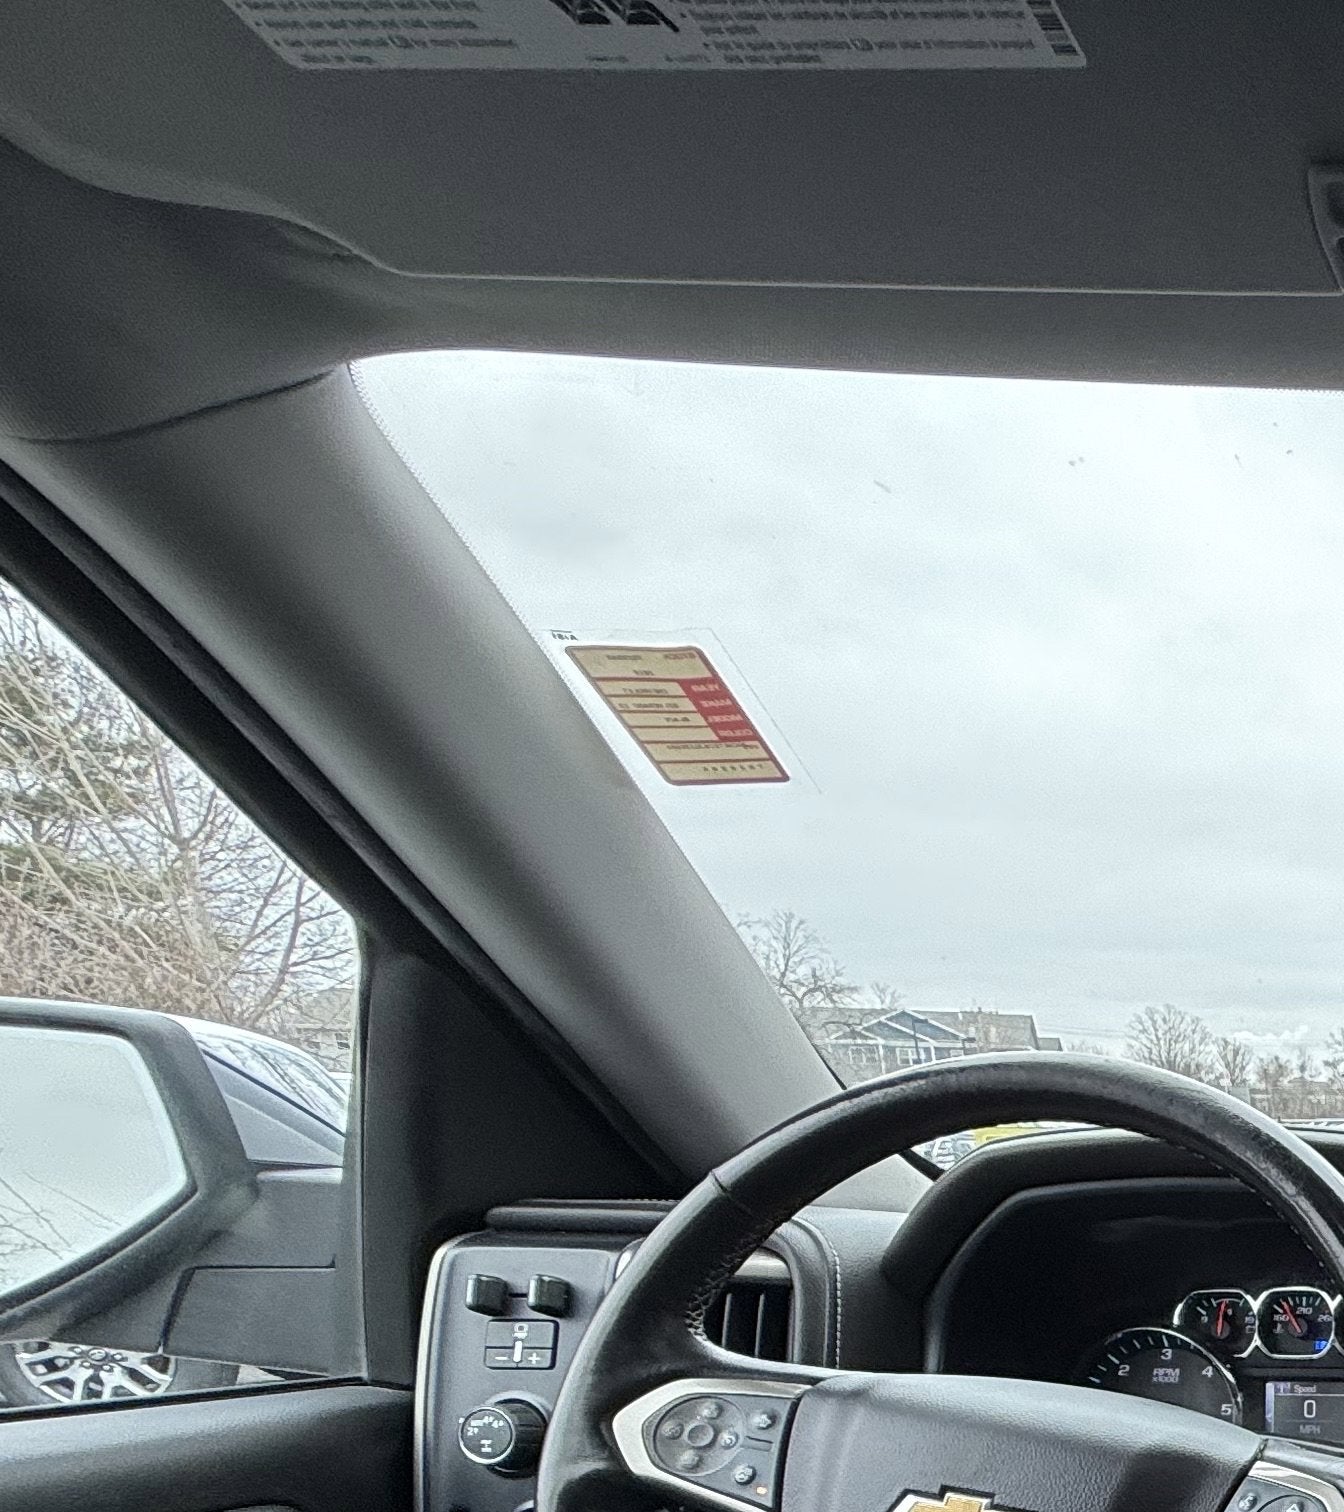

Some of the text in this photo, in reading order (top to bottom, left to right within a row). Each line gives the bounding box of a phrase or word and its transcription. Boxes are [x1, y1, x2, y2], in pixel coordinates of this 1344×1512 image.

[1161, 1348, 1173, 1361] 3
[1118, 1364, 1130, 1376] 2
[1153, 1368, 1180, 1376] RPM
[1201, 1366, 1213, 1377] 4
[1294, 1384, 1317, 1394] Speed
[1221, 1403, 1232, 1415] 5
[1303, 1400, 1316, 1418] 0
[1299, 1424, 1321, 1434] MPH
